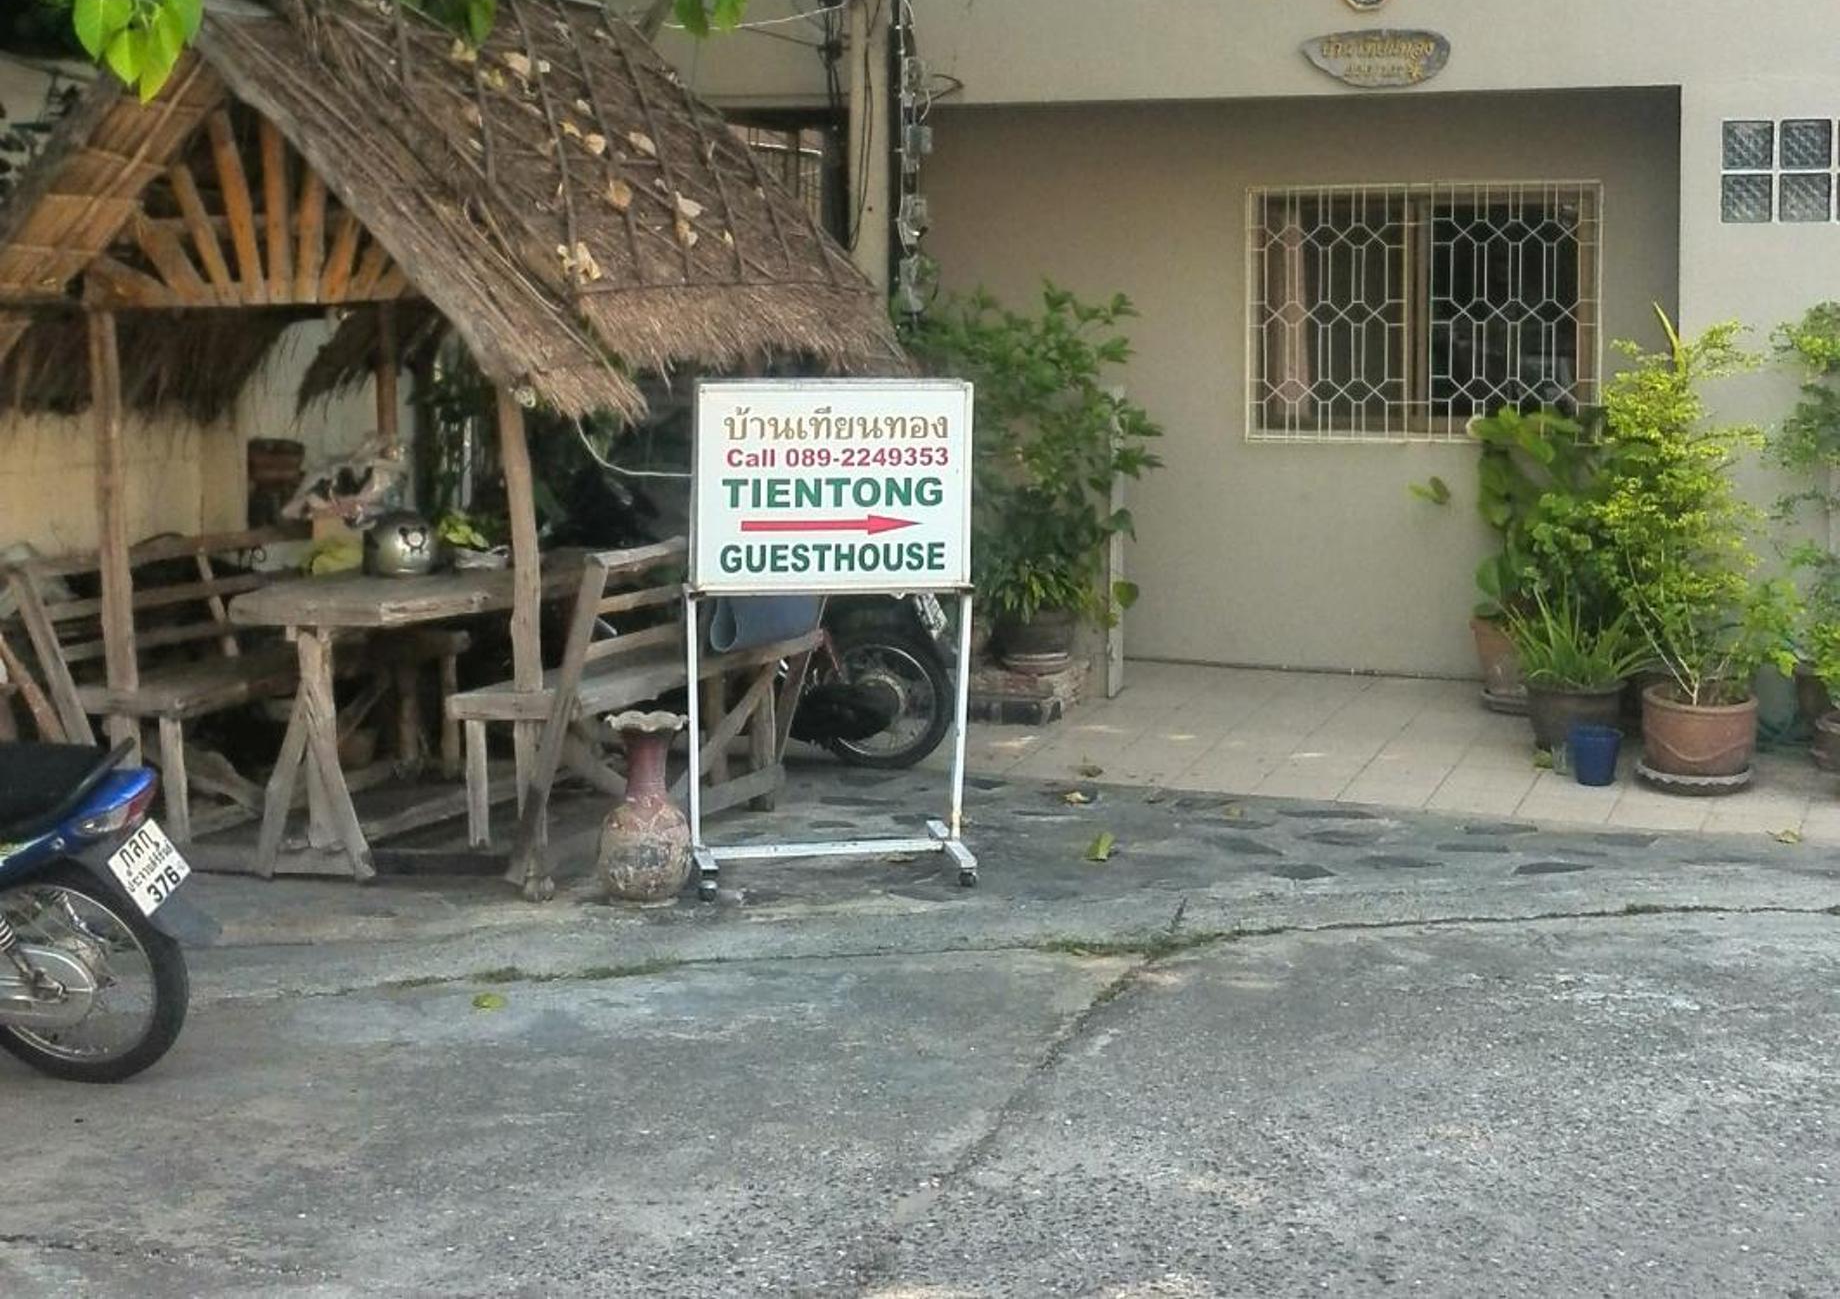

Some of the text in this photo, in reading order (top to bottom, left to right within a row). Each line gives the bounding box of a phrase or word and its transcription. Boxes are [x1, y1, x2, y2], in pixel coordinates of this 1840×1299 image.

[724, 406, 948, 440] บ้านเทียนทอง
[726, 447, 949, 468] Call 089-2249353
[722, 477, 943, 508] TIENTONG
[719, 542, 946, 573] GUESTHOUSE
[147, 865, 181, 903] 376
